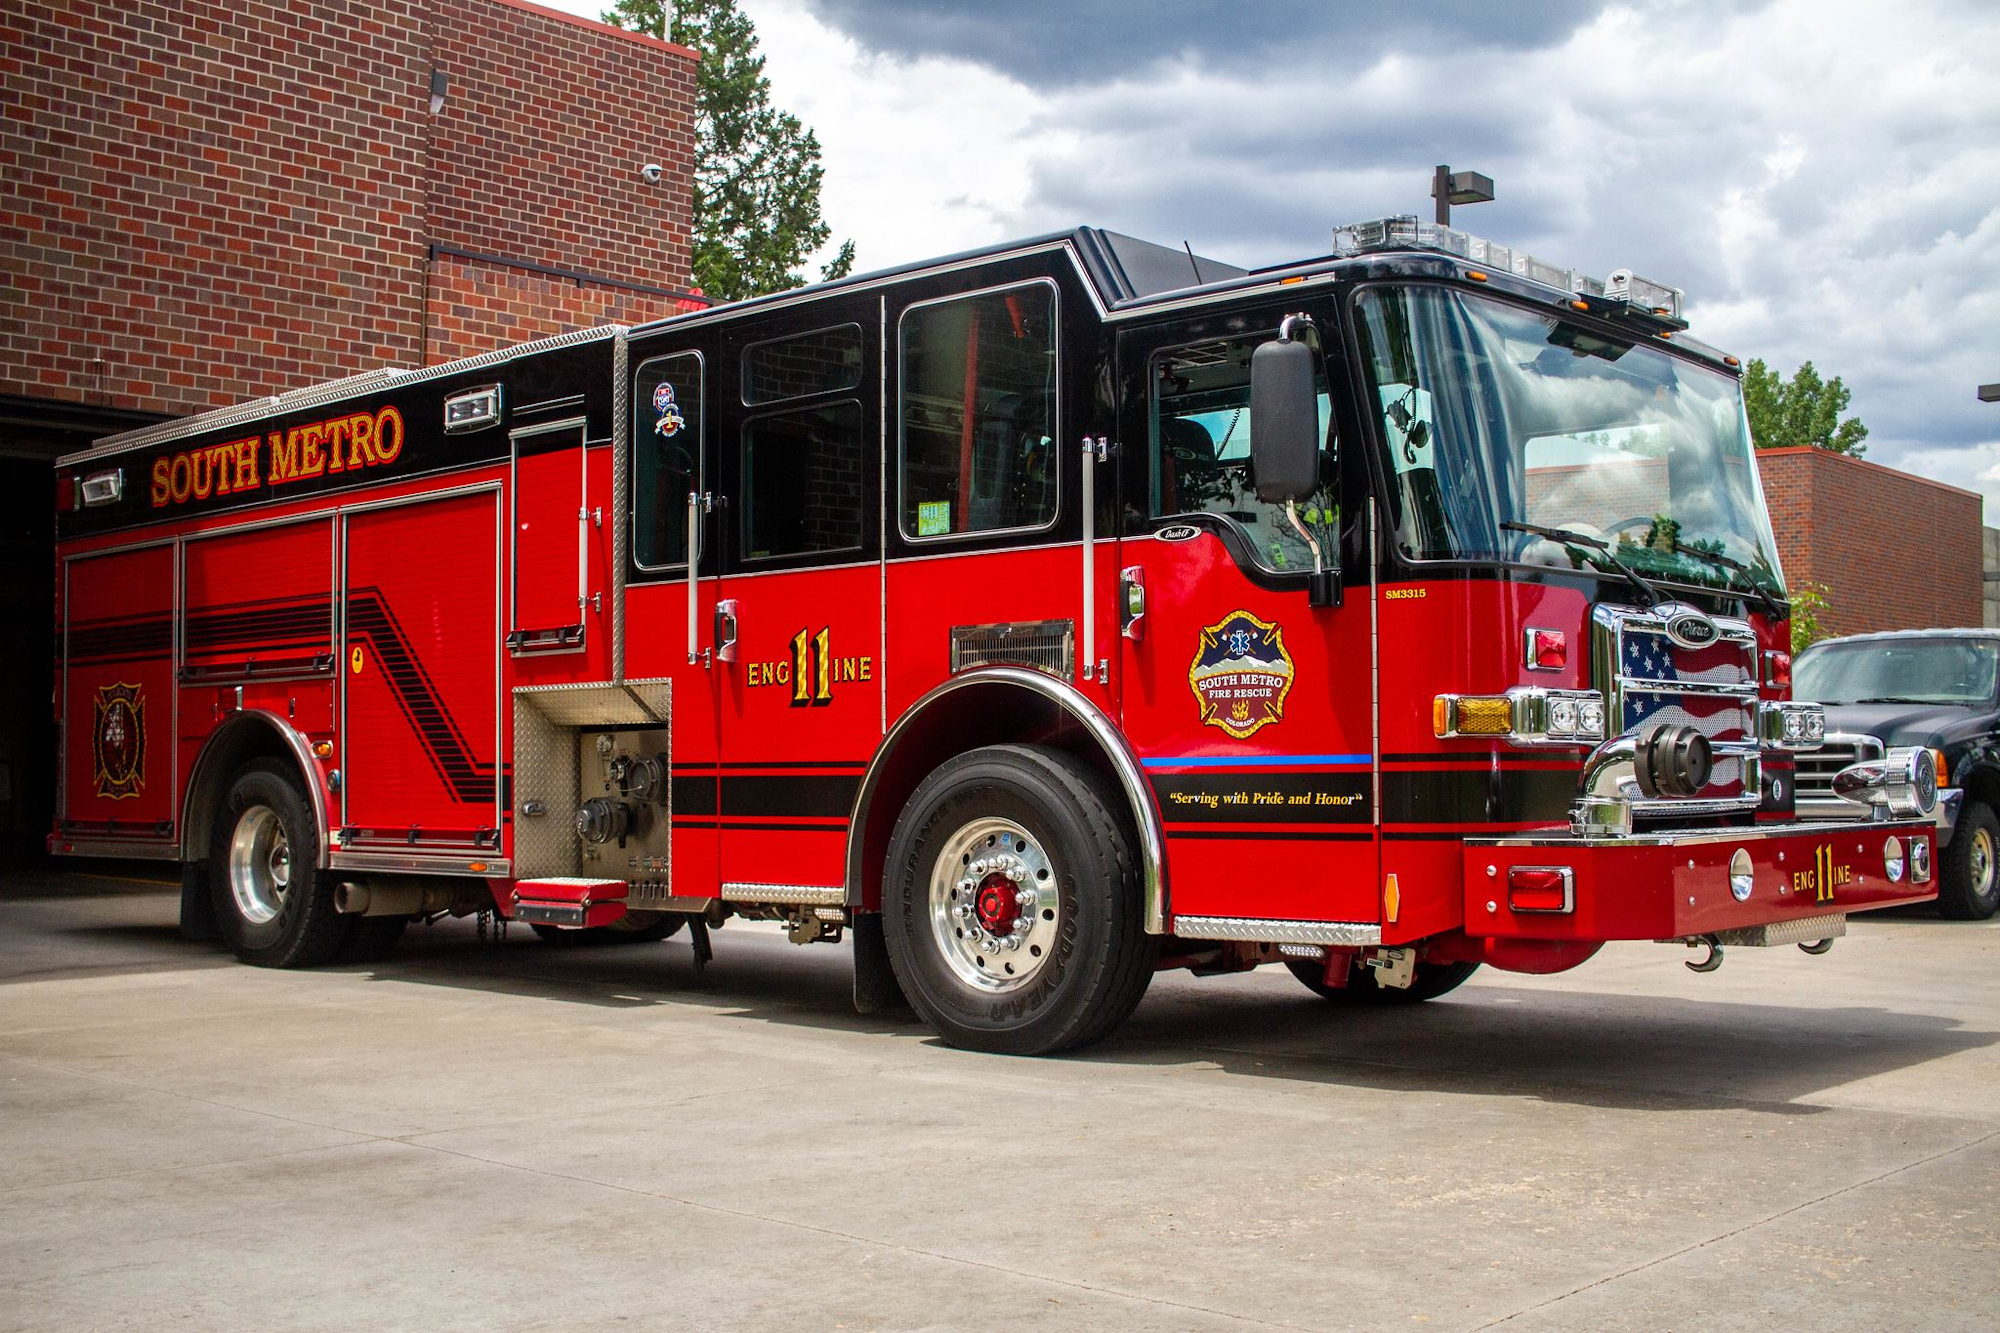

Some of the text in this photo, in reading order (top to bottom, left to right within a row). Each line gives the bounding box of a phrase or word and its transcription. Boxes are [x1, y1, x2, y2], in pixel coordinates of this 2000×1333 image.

[153, 405, 404, 508] SOUTH METRO
[1385, 588, 1427, 600] SM3315
[1680, 620, 1710, 639] Pierce
[747, 624, 872, 706] ENG 11 INE
[1198, 674, 1283, 691] SOUTH METRO
[1208, 688, 1273, 699] FIRE RESCUE
[1225, 717, 1255, 728] COLORADO
[1223, 791, 1249, 805] with
[1252, 792, 1285, 805] Pride
[1288, 792, 1311, 805] and
[1793, 843, 1851, 905] ENG 11 INE
